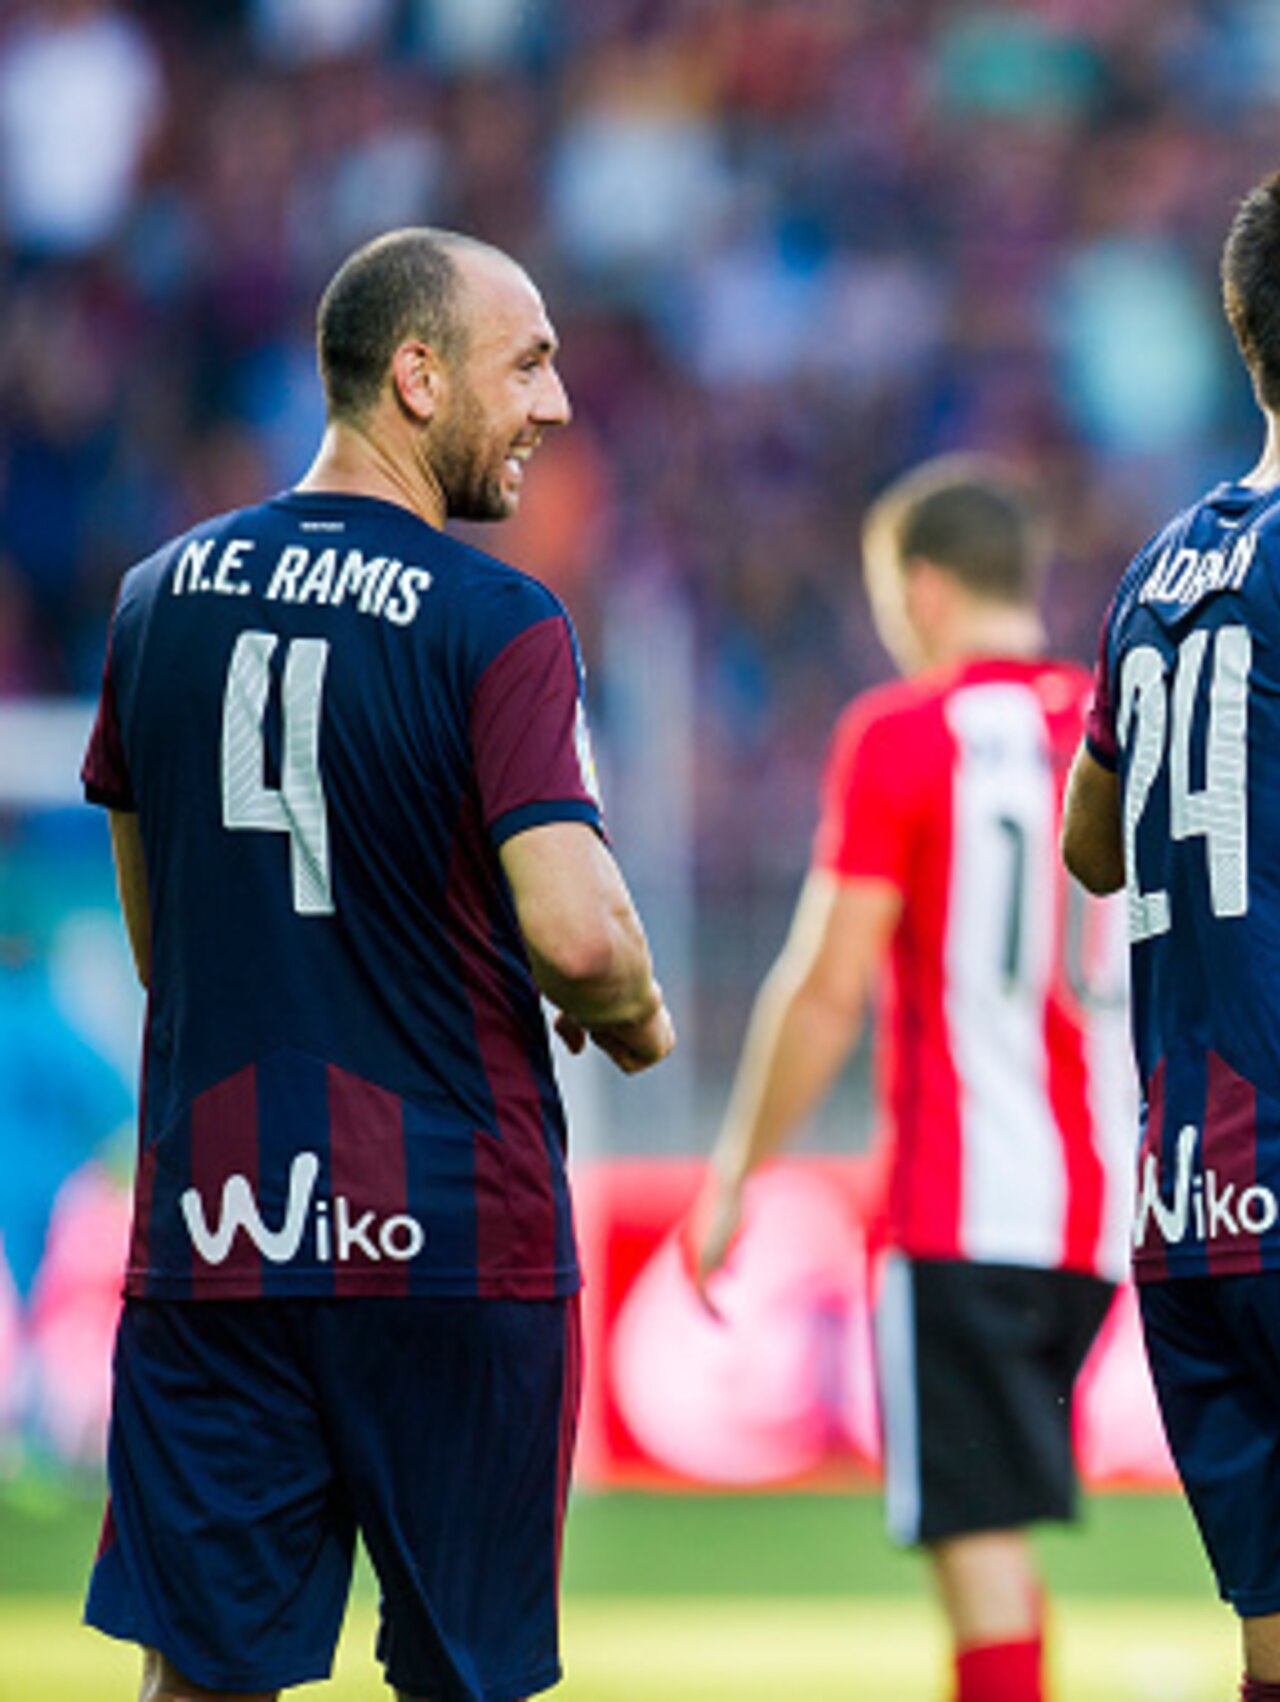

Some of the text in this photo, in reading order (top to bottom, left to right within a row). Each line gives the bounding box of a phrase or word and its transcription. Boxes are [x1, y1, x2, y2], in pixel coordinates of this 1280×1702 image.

[173, 540, 431, 626] N.E. RAMIS
[222, 631, 334, 914] 4
[1117, 625, 1251, 943] 24
[181, 1152, 424, 1263] Wiko
